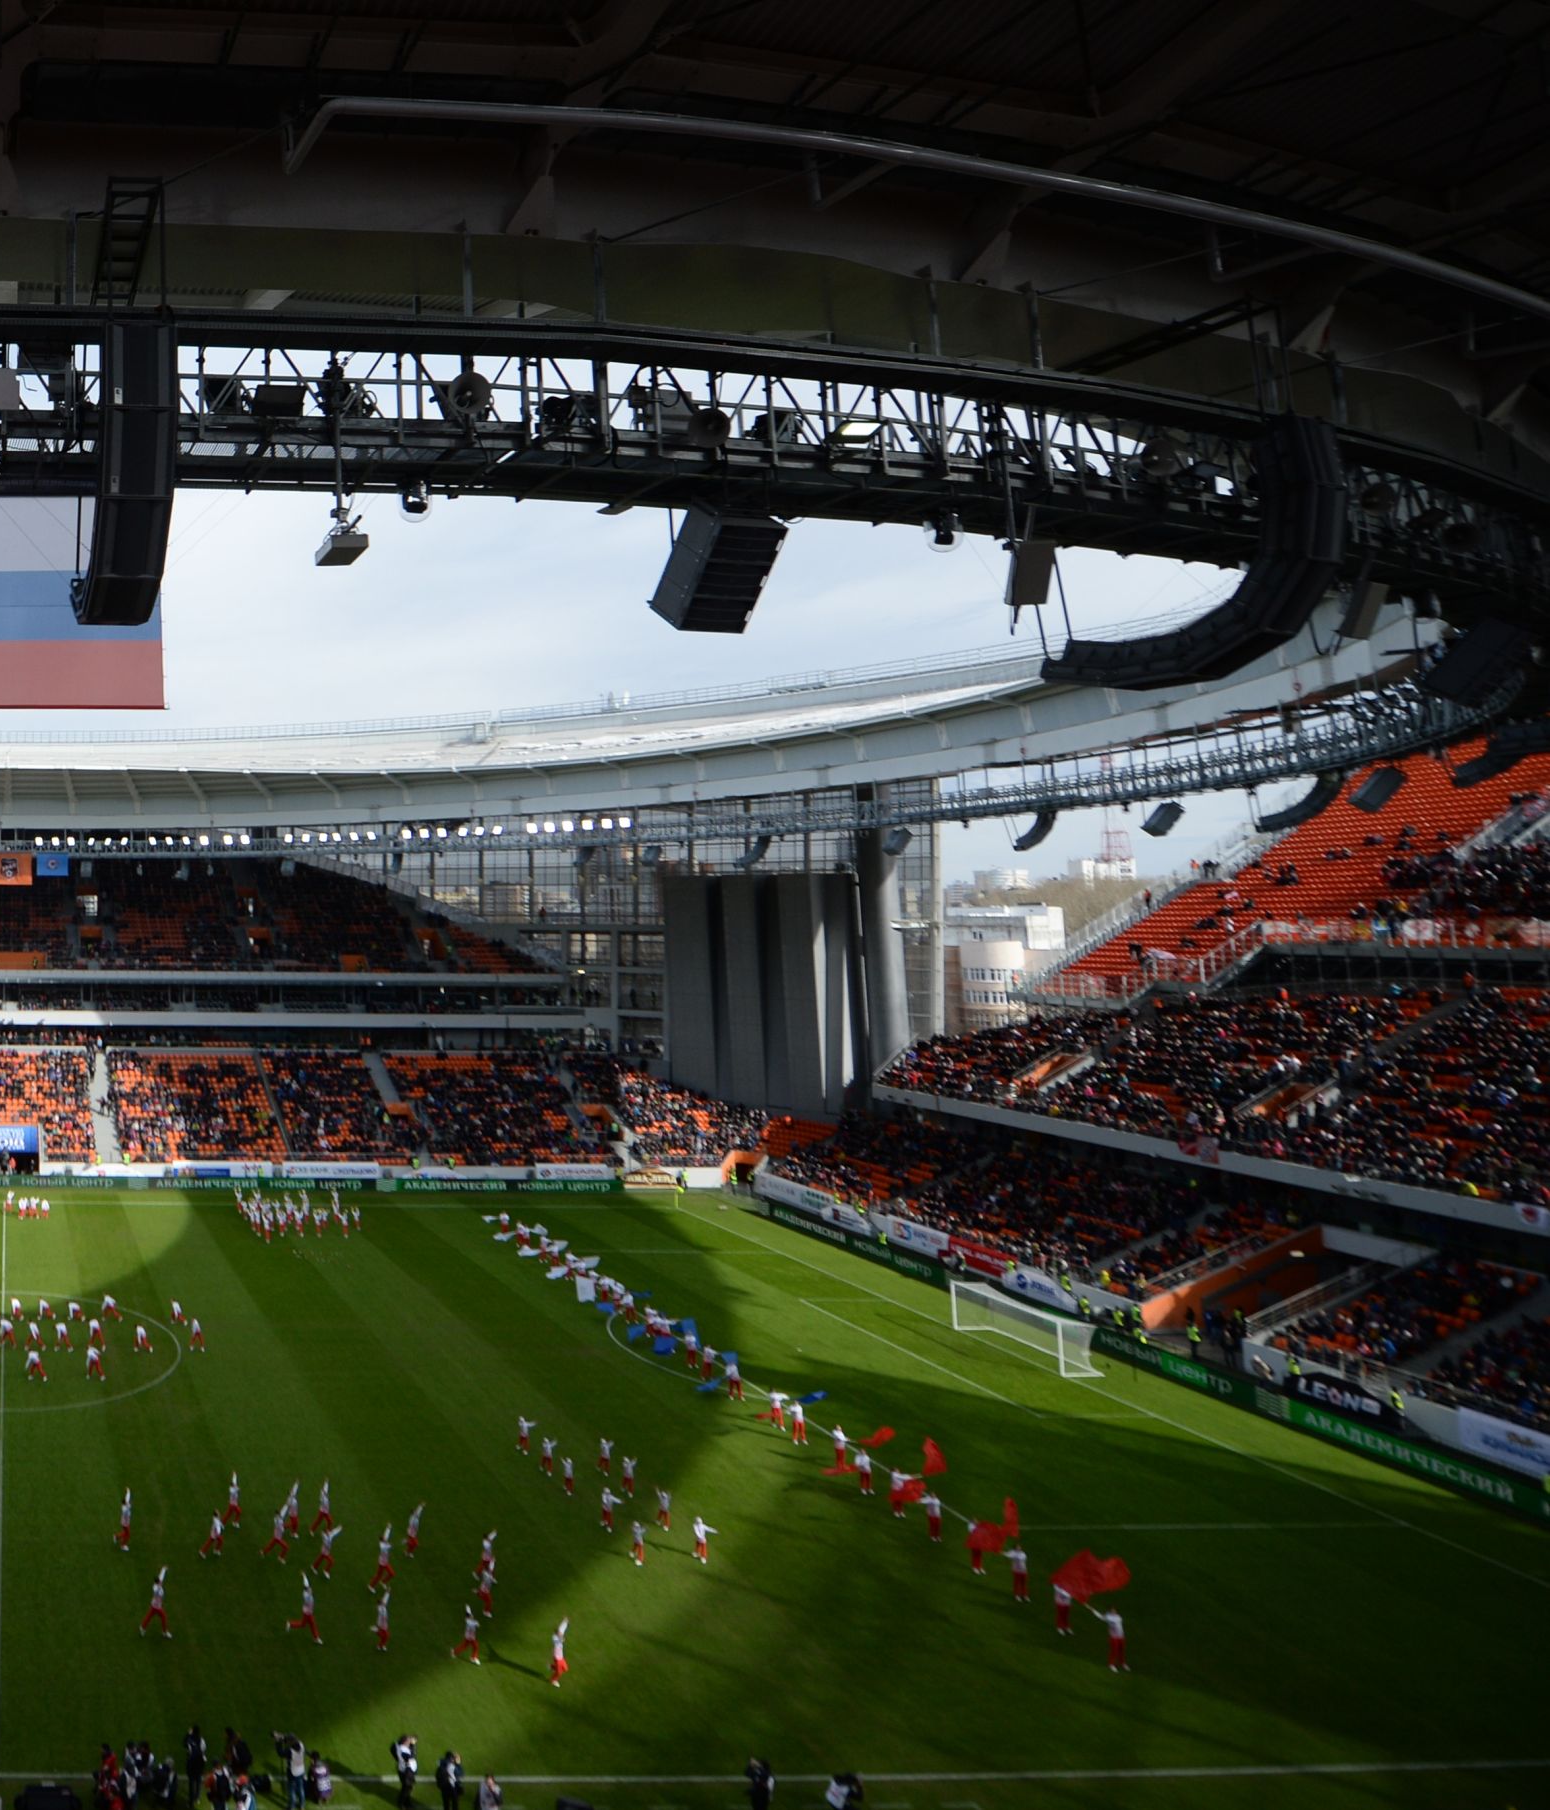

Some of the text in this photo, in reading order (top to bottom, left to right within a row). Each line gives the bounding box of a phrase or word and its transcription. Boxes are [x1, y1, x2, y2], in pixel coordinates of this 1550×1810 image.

[156, 1178, 258, 1189] АКАДЕМИЧЕСКИЙ
[404, 1179, 507, 1191] АКАДЕМИЧЕСКИЙ
[773, 1208, 847, 1245] АКАДЕМИЧЕСКИЙ
[1304, 1411, 1515, 1502] АКАДЕМИЧЕСКИЙ
